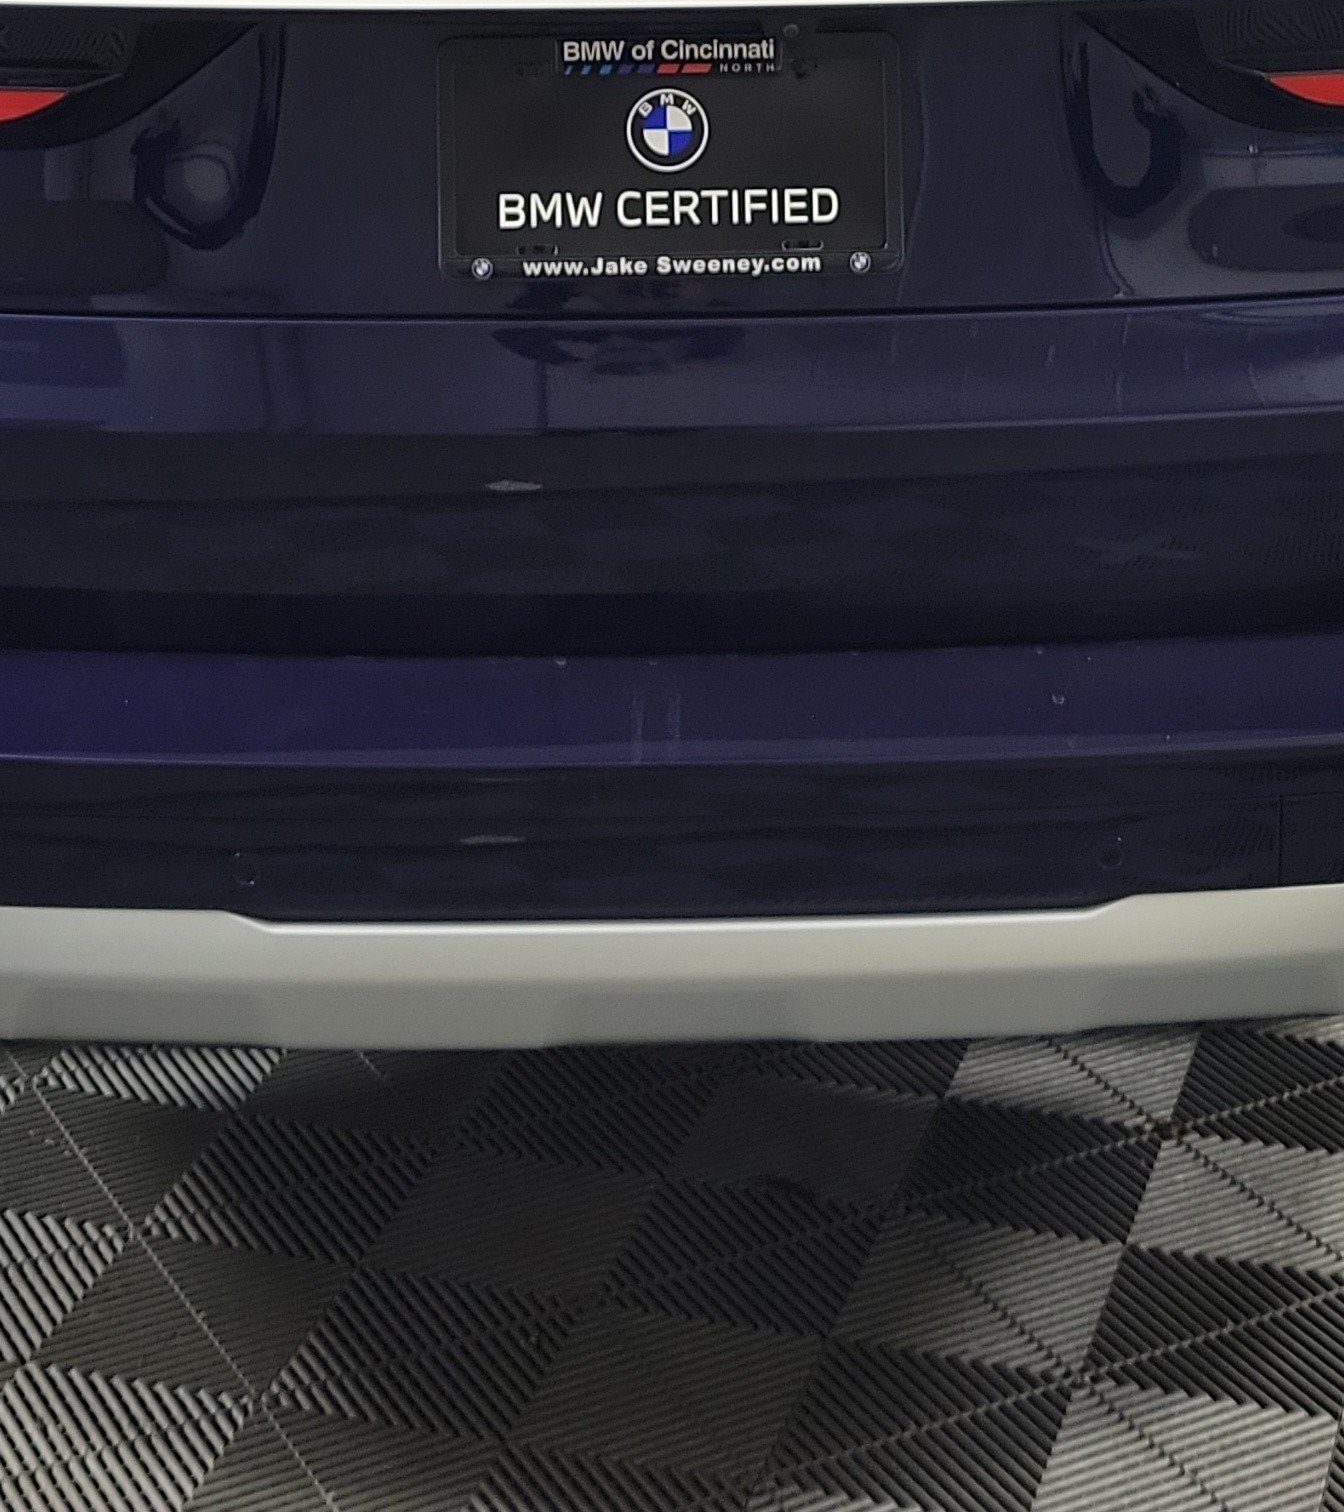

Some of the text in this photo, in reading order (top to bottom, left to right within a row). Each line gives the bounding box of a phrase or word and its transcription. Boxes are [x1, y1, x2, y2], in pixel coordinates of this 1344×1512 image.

[563, 38, 775, 61] BMW of Cincinnati
[719, 62, 775, 73] NORTH
[638, 93, 696, 118] BMW
[498, 187, 840, 230] BMW CERTIFIED
[523, 255, 822, 277] www.Jake Sweeney.com
